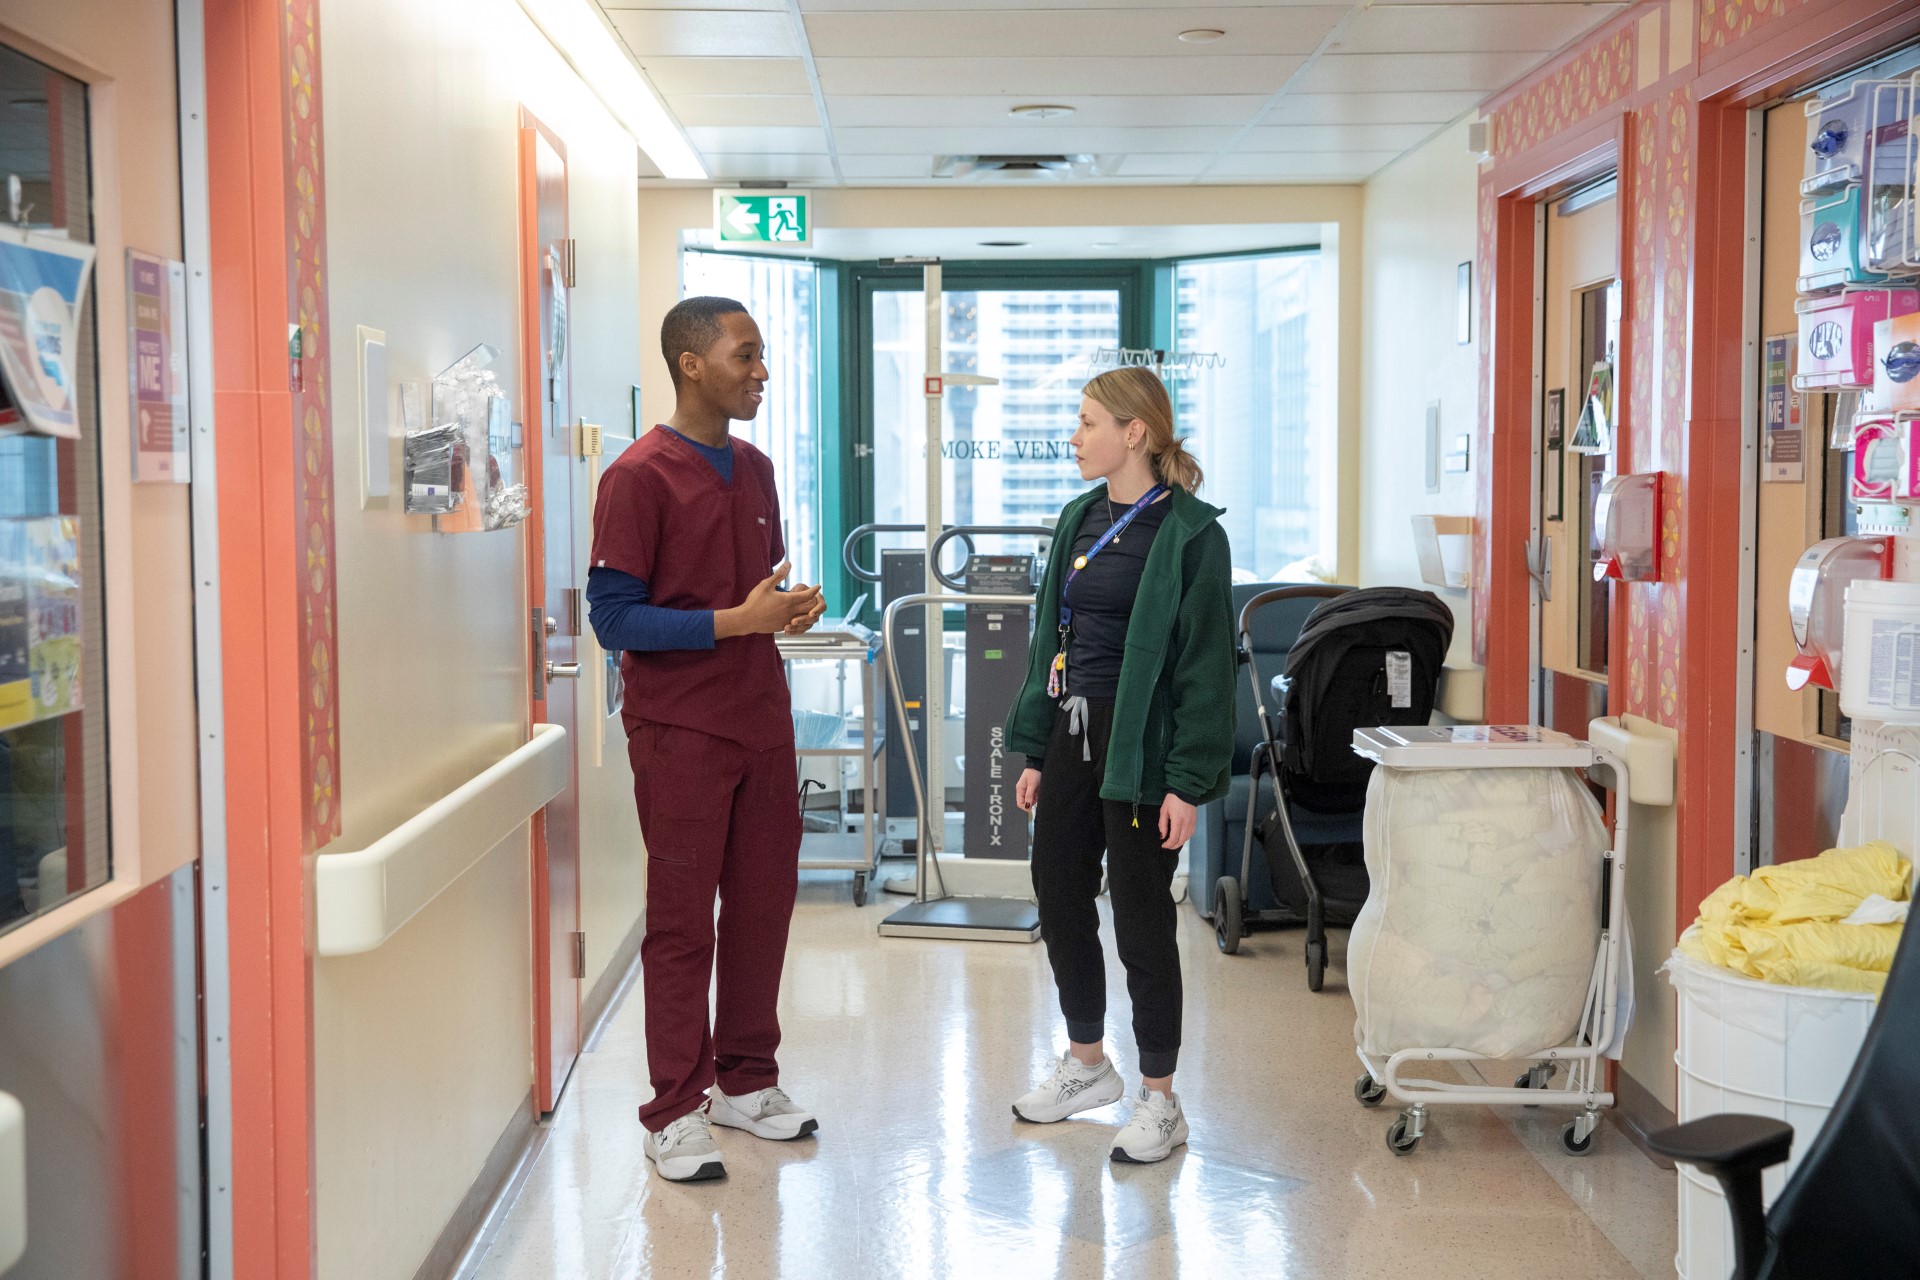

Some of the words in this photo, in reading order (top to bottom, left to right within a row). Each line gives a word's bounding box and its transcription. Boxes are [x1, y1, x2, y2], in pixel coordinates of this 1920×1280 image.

[1768, 400, 1783, 424] ME
[922, 440, 1000, 459] MOKE
[990, 726, 1003, 779] SCALE
[989, 784, 1003, 846] TRONIX
